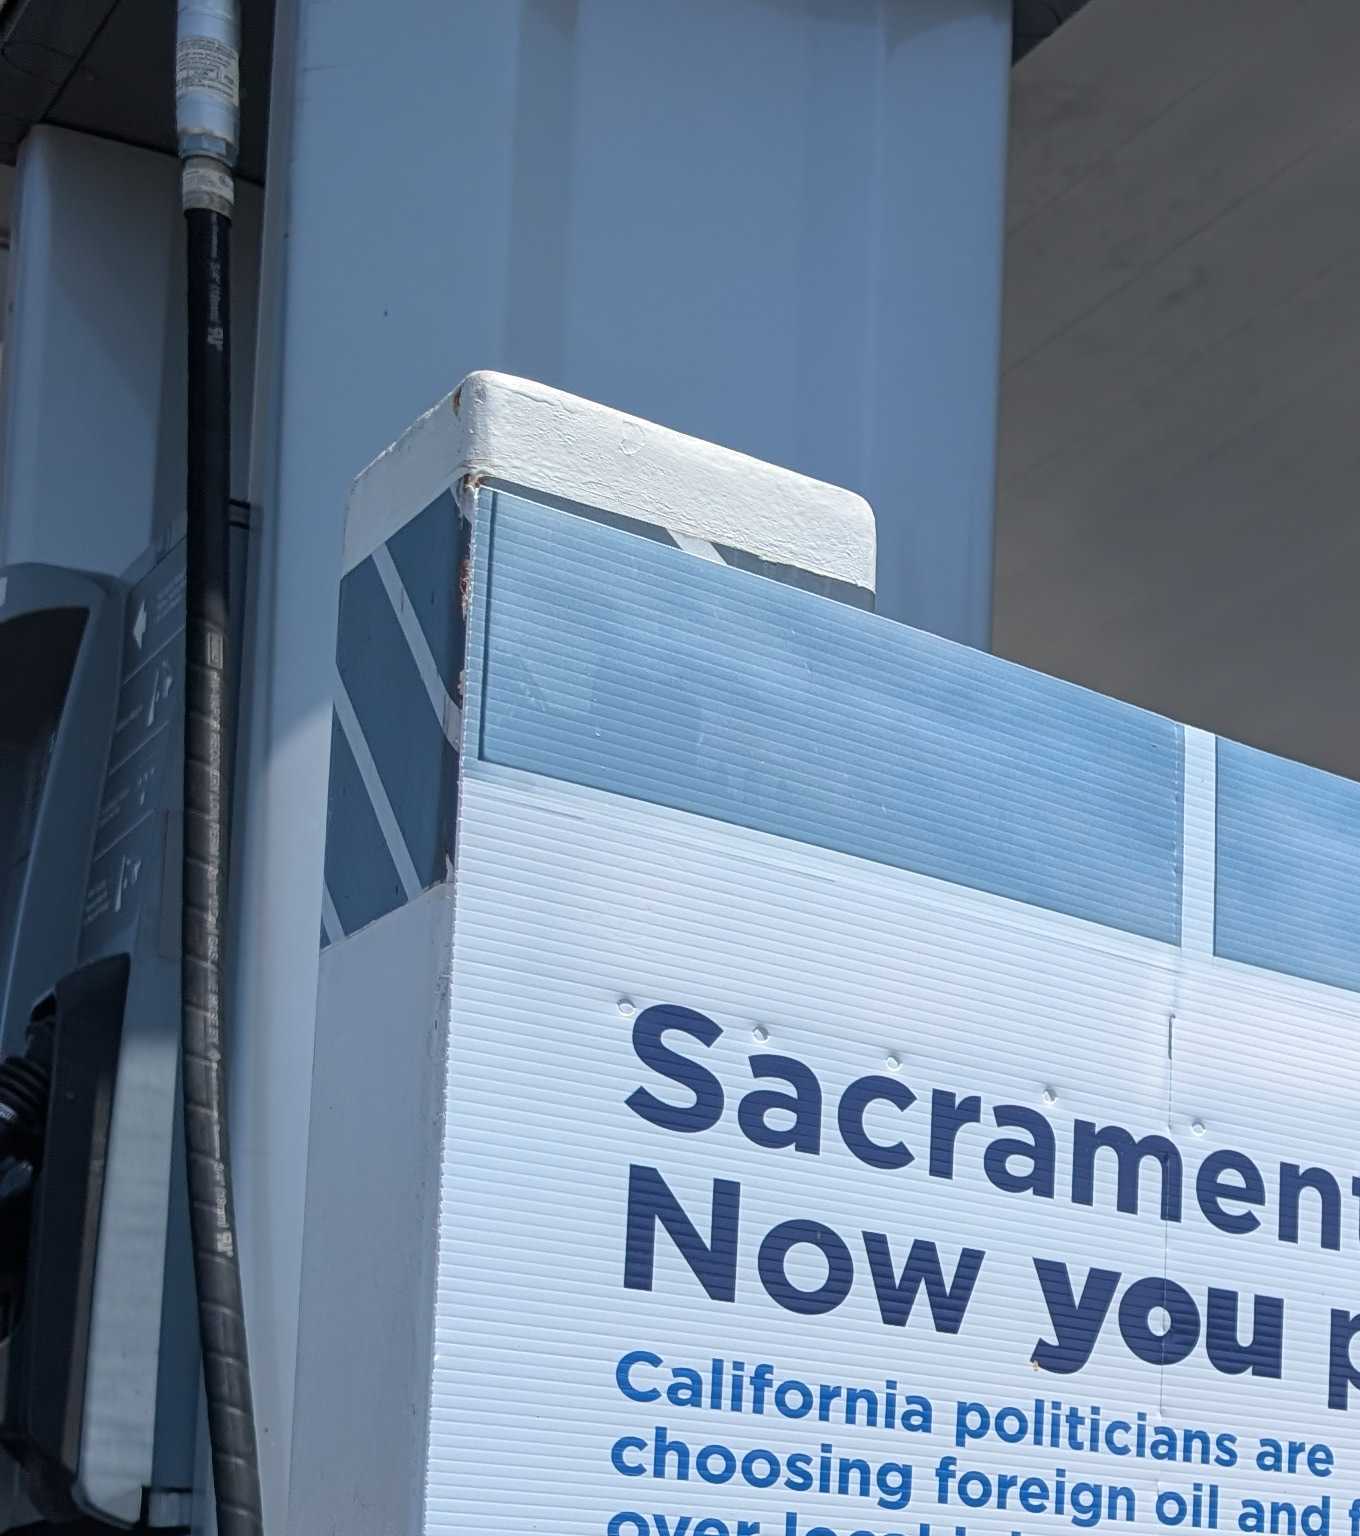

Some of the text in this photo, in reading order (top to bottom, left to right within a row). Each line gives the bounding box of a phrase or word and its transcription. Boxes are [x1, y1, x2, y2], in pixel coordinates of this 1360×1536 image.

[622, 1163, 987, 1336] Now
[1029, 1257, 1284, 1380] you
[609, 1425, 914, 1512] choosing
[934, 1455, 1137, 1529] foreign
[1154, 1482, 1220, 1531] oil
[614, 1350, 1335, 1478] California politicians are
